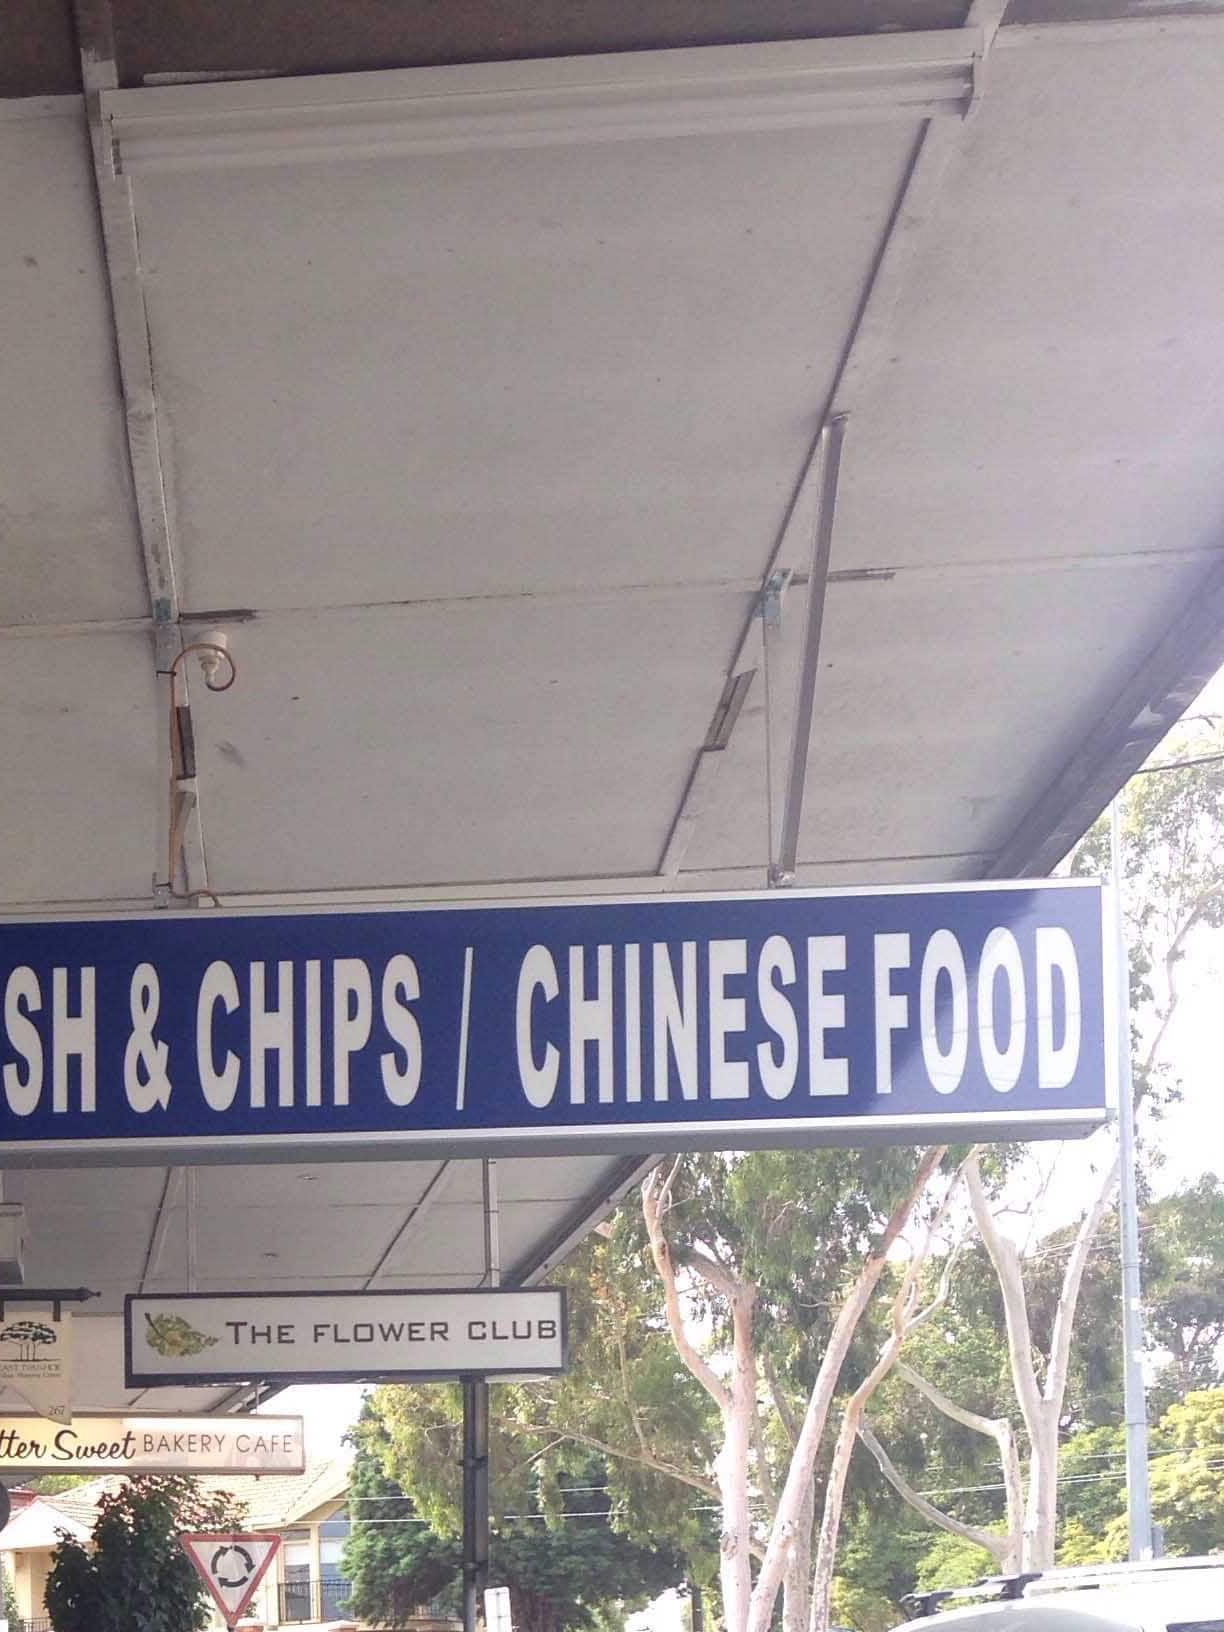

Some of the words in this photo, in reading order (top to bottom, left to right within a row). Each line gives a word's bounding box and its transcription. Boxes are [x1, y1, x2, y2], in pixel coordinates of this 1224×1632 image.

[123, 962, 173, 1113] &
[196, 953, 423, 1112] CHIPS
[515, 935, 850, 1109] CHINESE
[873, 926, 1082, 1095] FOOD
[225, 1320, 295, 1345] THE
[313, 1320, 450, 1344] FLOWER
[467, 1319, 557, 1341] CLUB
[51, 1429, 136, 1461] Sweet
[143, 1433, 226, 1453] BAKERY
[236, 1433, 293, 1453] CAFE
